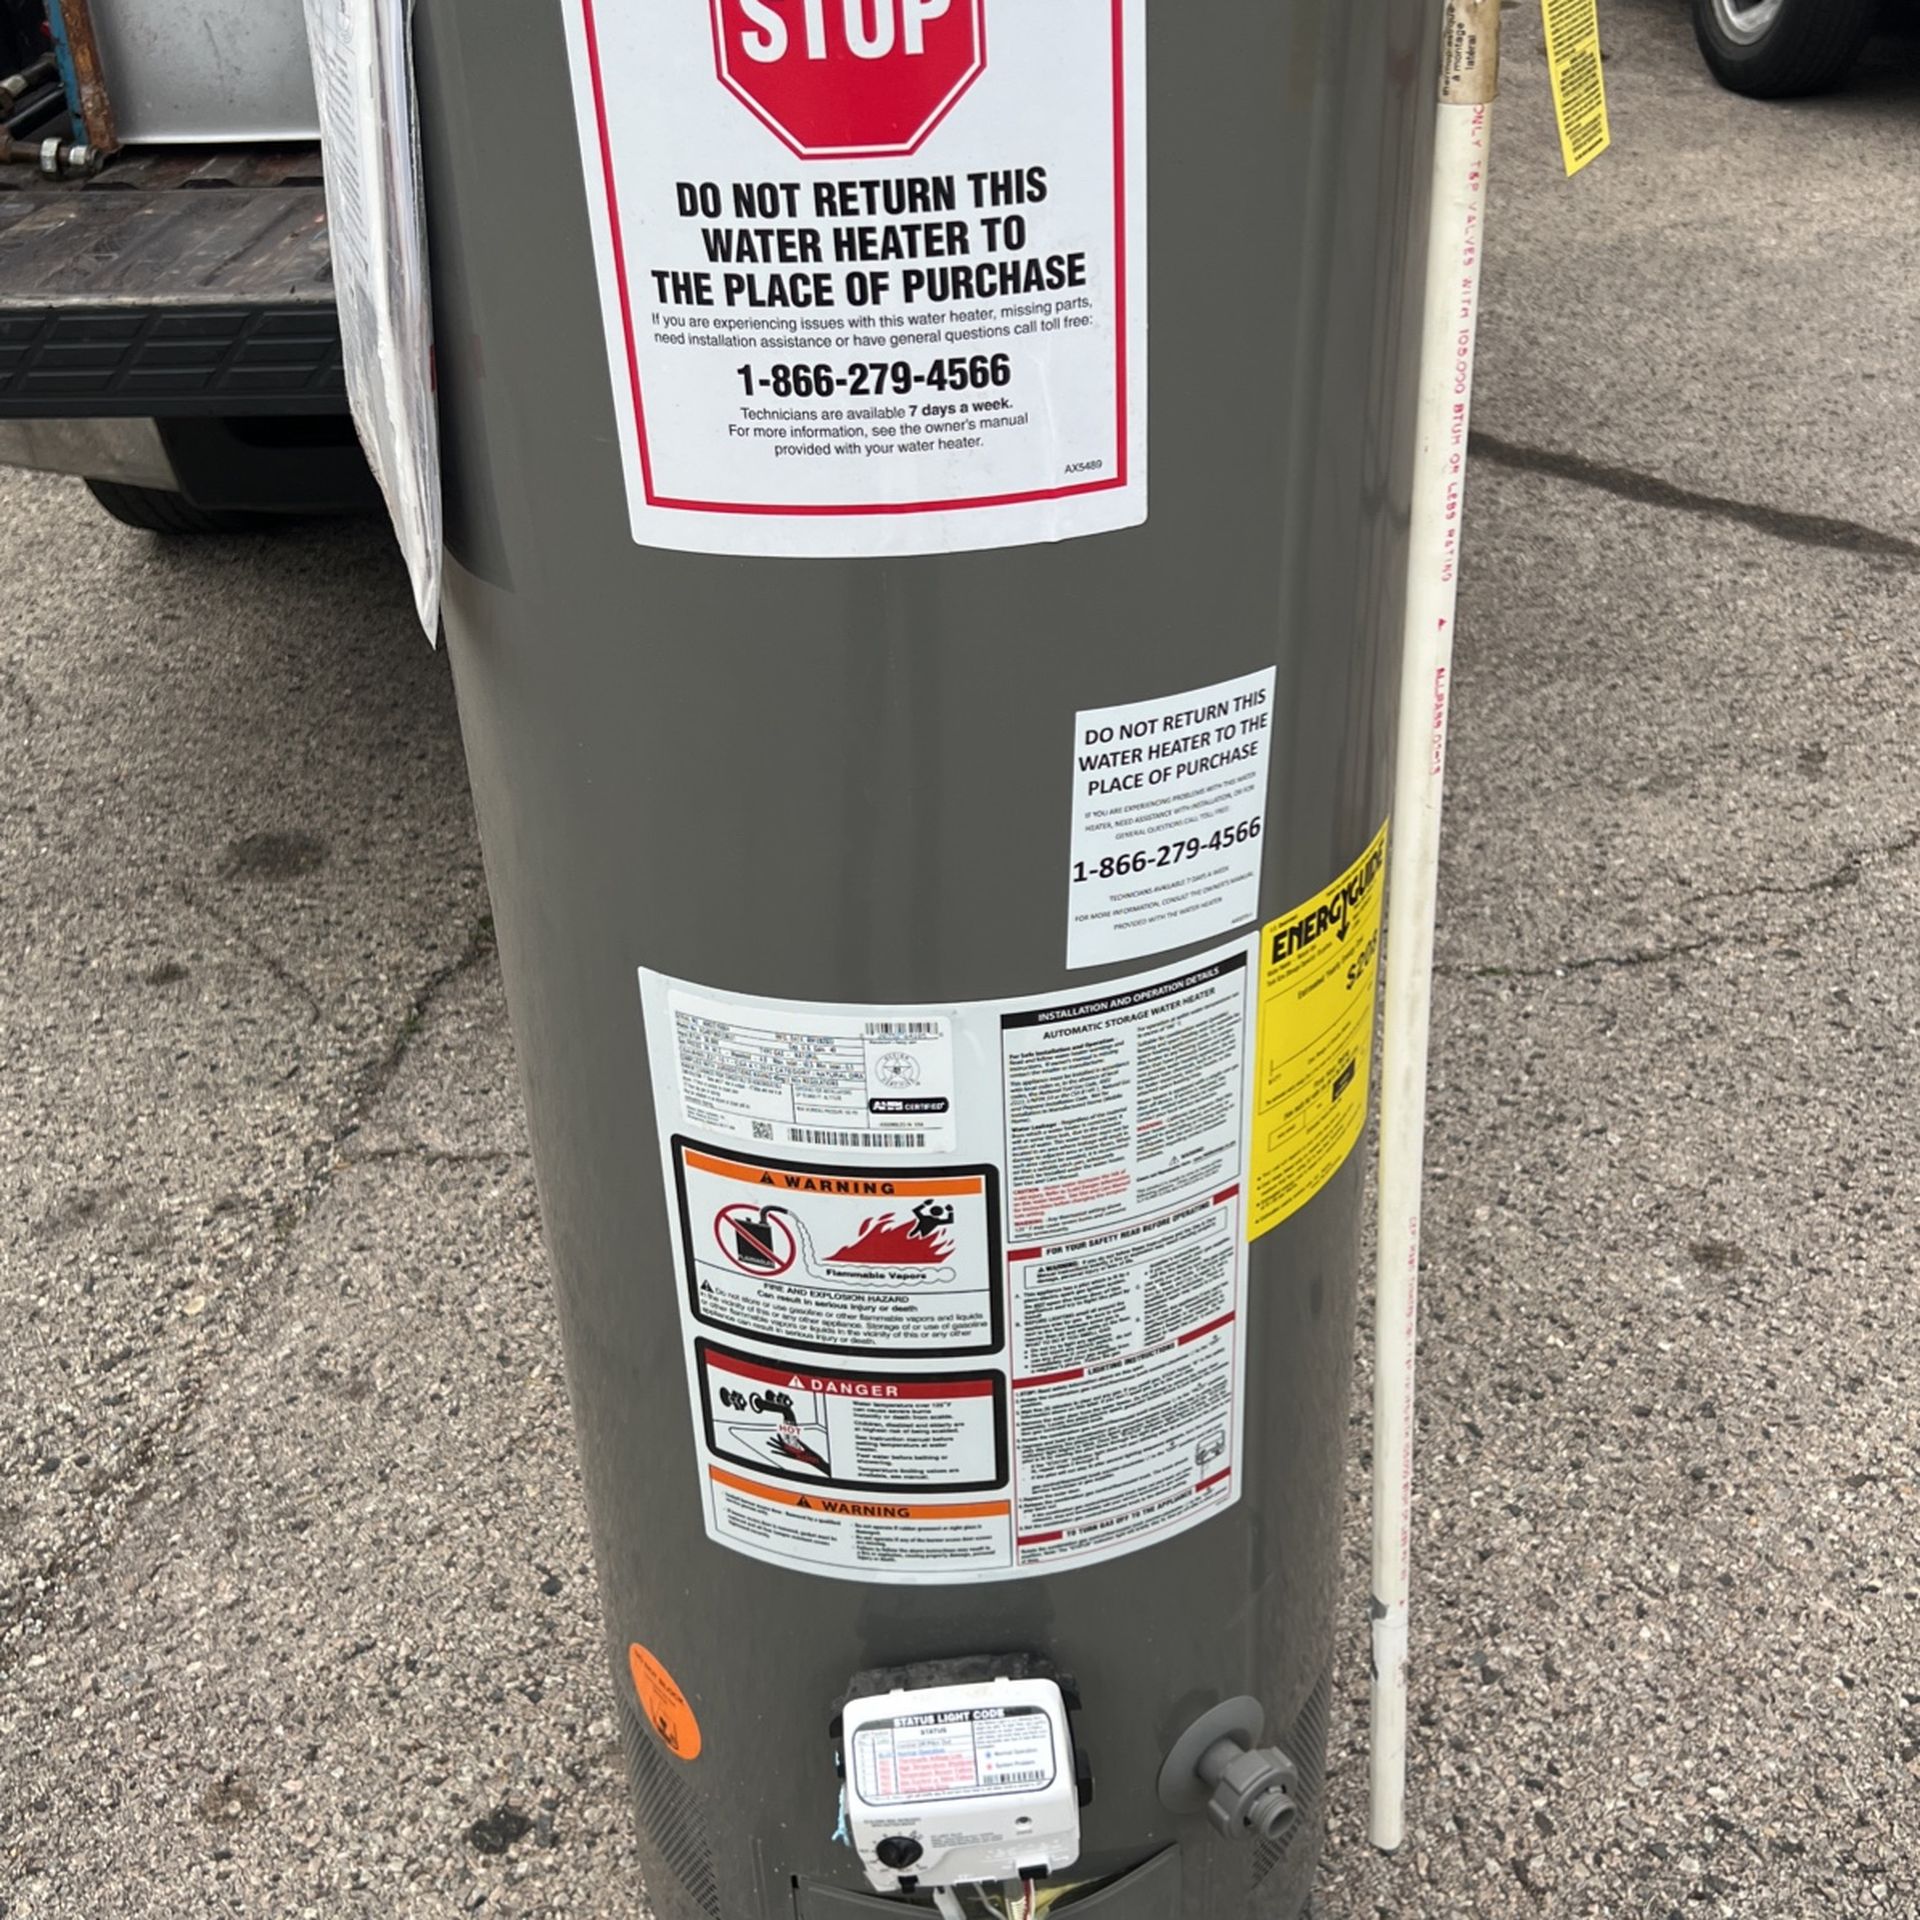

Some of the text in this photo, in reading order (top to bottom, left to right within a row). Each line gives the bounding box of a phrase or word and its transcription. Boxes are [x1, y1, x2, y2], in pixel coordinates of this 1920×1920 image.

[740, 0, 951, 63] STOP
[1453, 22, 1466, 71] montage
[1465, 34, 1476, 70] latéral
[675, 166, 1047, 218] DO NOT RETURN THIS
[701, 214, 1026, 262] WATER HEATER TO
[651, 252, 1086, 307] THE PLACE OF PURCHASE
[650, 296, 1096, 332] If you are experiencing issues with this water heater, missing parts,
[653, 313, 1097, 349] need installation assistance or have general questions call toll free:
[737, 353, 1011, 398] 1-866-279-4566
[728, 411, 1028, 440] For more information, see the owner's manual
[740, 396, 1013, 420] Technicians are available 7 days a week.
[775, 434, 988, 458] provided with your water heater.
[1084, 688, 1267, 744] DO NOT RETURN THIS
[1078, 707, 1269, 771] WATER HEATER TO THE
[1087, 740, 1260, 795] PLACE OF PURCHASE
[1073, 816, 1261, 882] 1-866-279-4566
[1038, 966, 1220, 1022] INSTALLATION AND OPERATION DETAILS
[1043, 985, 1216, 1040] AUTOMATIC STORAGE WATER HEATER
[784, 1176, 896, 1194] WARNING
[1046, 1246, 1063, 1255] FOR
[1065, 1241, 1086, 1253] YOUR
[1088, 1234, 1118, 1248] SAFETY
[1142, 1217, 1171, 1234] BEFORE
[763, 1282, 784, 1292] FIRE
[786, 1286, 807, 1296] AND
[809, 1289, 866, 1302] EXPLOSION
[826, 1268, 926, 1280] Flammable Vapors
[756, 1289, 774, 1299] Can
[776, 1292, 801, 1304] result
[803, 1297, 812, 1305] in
[814, 1299, 848, 1309] serious
[849, 1302, 876, 1312] injury
[811, 1379, 898, 1397] DANGER
[778, 1424, 802, 1435] HOT
[821, 1501, 910, 1518] WARNING
[894, 1709, 1005, 1728] STATUS LIGHT CODE
